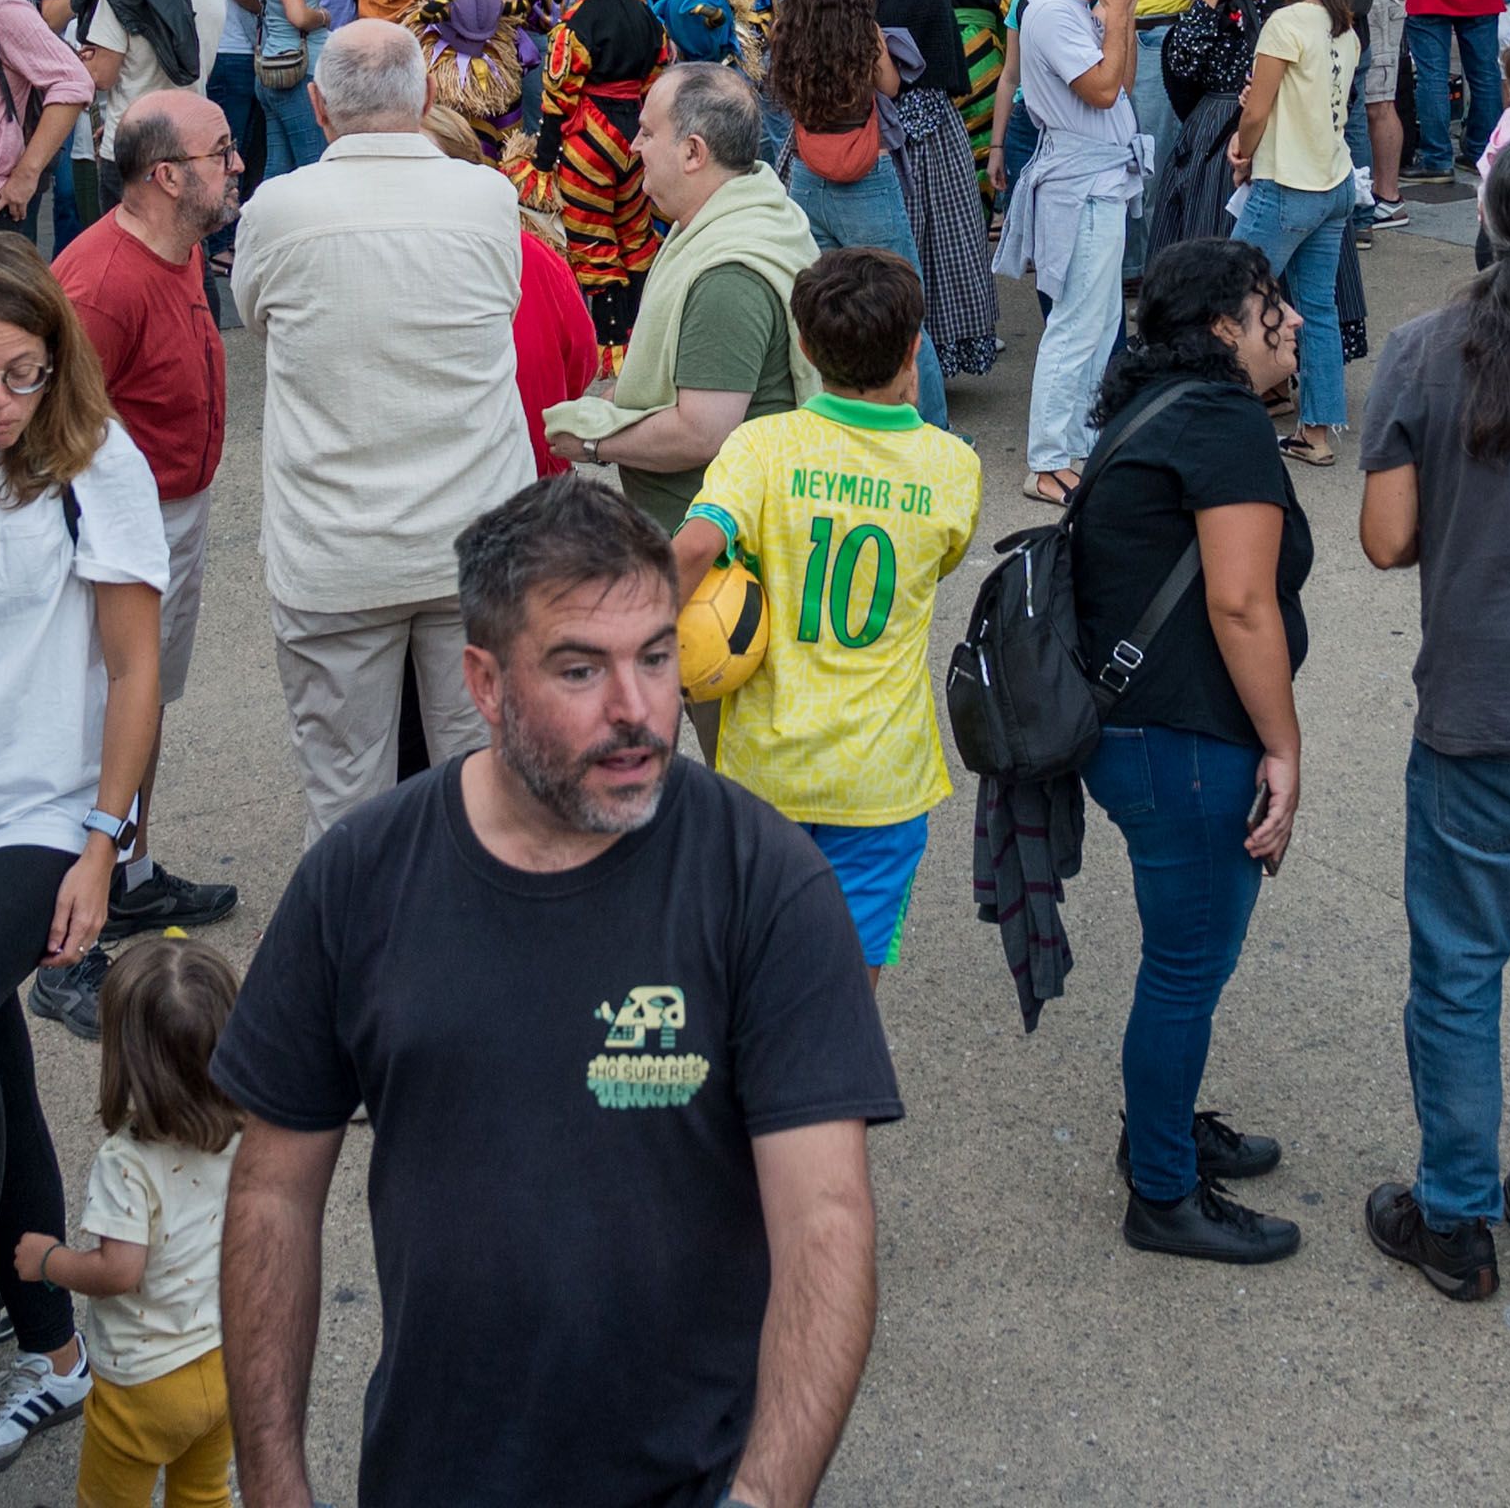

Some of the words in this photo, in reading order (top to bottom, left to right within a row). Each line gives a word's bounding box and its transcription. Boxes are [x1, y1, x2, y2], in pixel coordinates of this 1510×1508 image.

[791, 468, 891, 509] NEYMAR
[901, 483, 932, 516] JR
[797, 516, 897, 649] 10
[595, 1064, 618, 1079] HO
[623, 1064, 701, 1081] SUPERES
